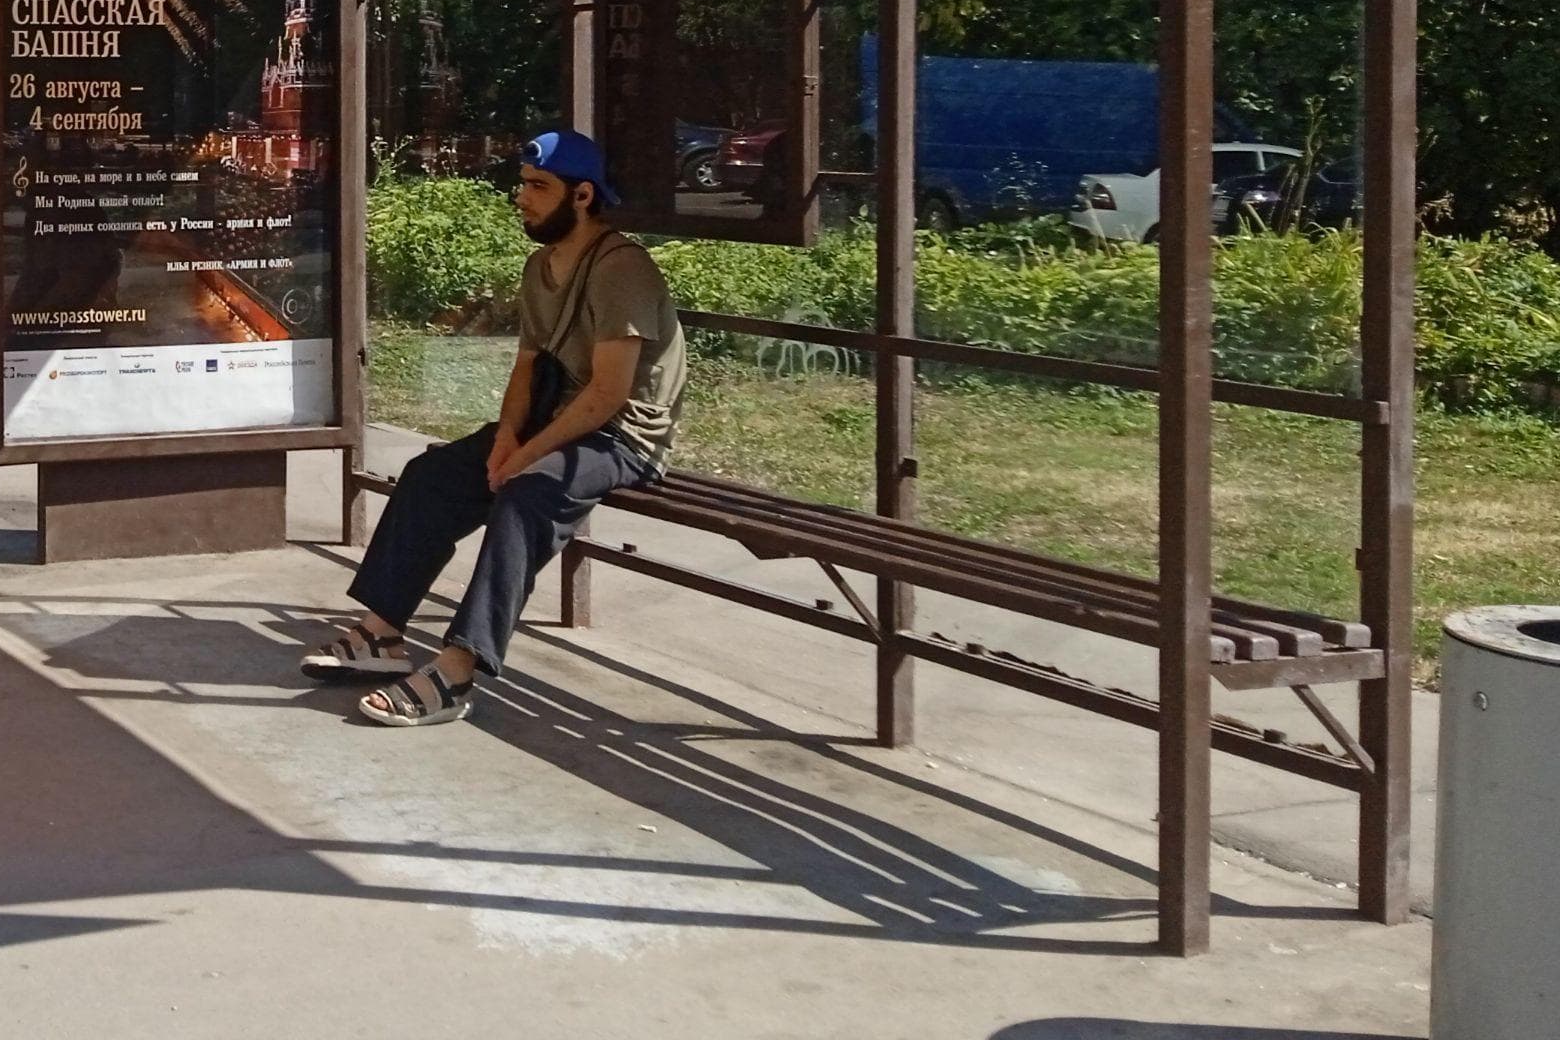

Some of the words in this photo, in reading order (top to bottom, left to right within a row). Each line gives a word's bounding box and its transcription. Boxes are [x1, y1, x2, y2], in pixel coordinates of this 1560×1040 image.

[11, 30, 121, 58] БАШНЯ
[10, 73, 36, 99] 26
[45, 80, 122, 103] августа
[29, 105, 43, 130] 4
[52, 105, 143, 135] сентября
[35, 171, 49, 184] На
[53, 173, 81, 186] суше,
[84, 173, 96, 182] на
[99, 173, 122, 184] море
[146, 169, 167, 182] небе
[35, 196, 53, 208] Мы
[58, 195, 95, 209] Родины
[99, 194, 129, 207] нашей
[34, 220, 54, 236] Два
[58, 222, 94, 234] верных
[97, 221, 143, 231] союзника
[146, 222, 167, 231] есть
[170, 221, 177, 232] у
[180, 217, 214, 230] России
[226, 219, 254, 231] армия
[266, 214, 292, 230] флот!
[166, 261, 190, 272] ИЛЬЯ
[11, 308, 146, 328] www.spasstower.ru
